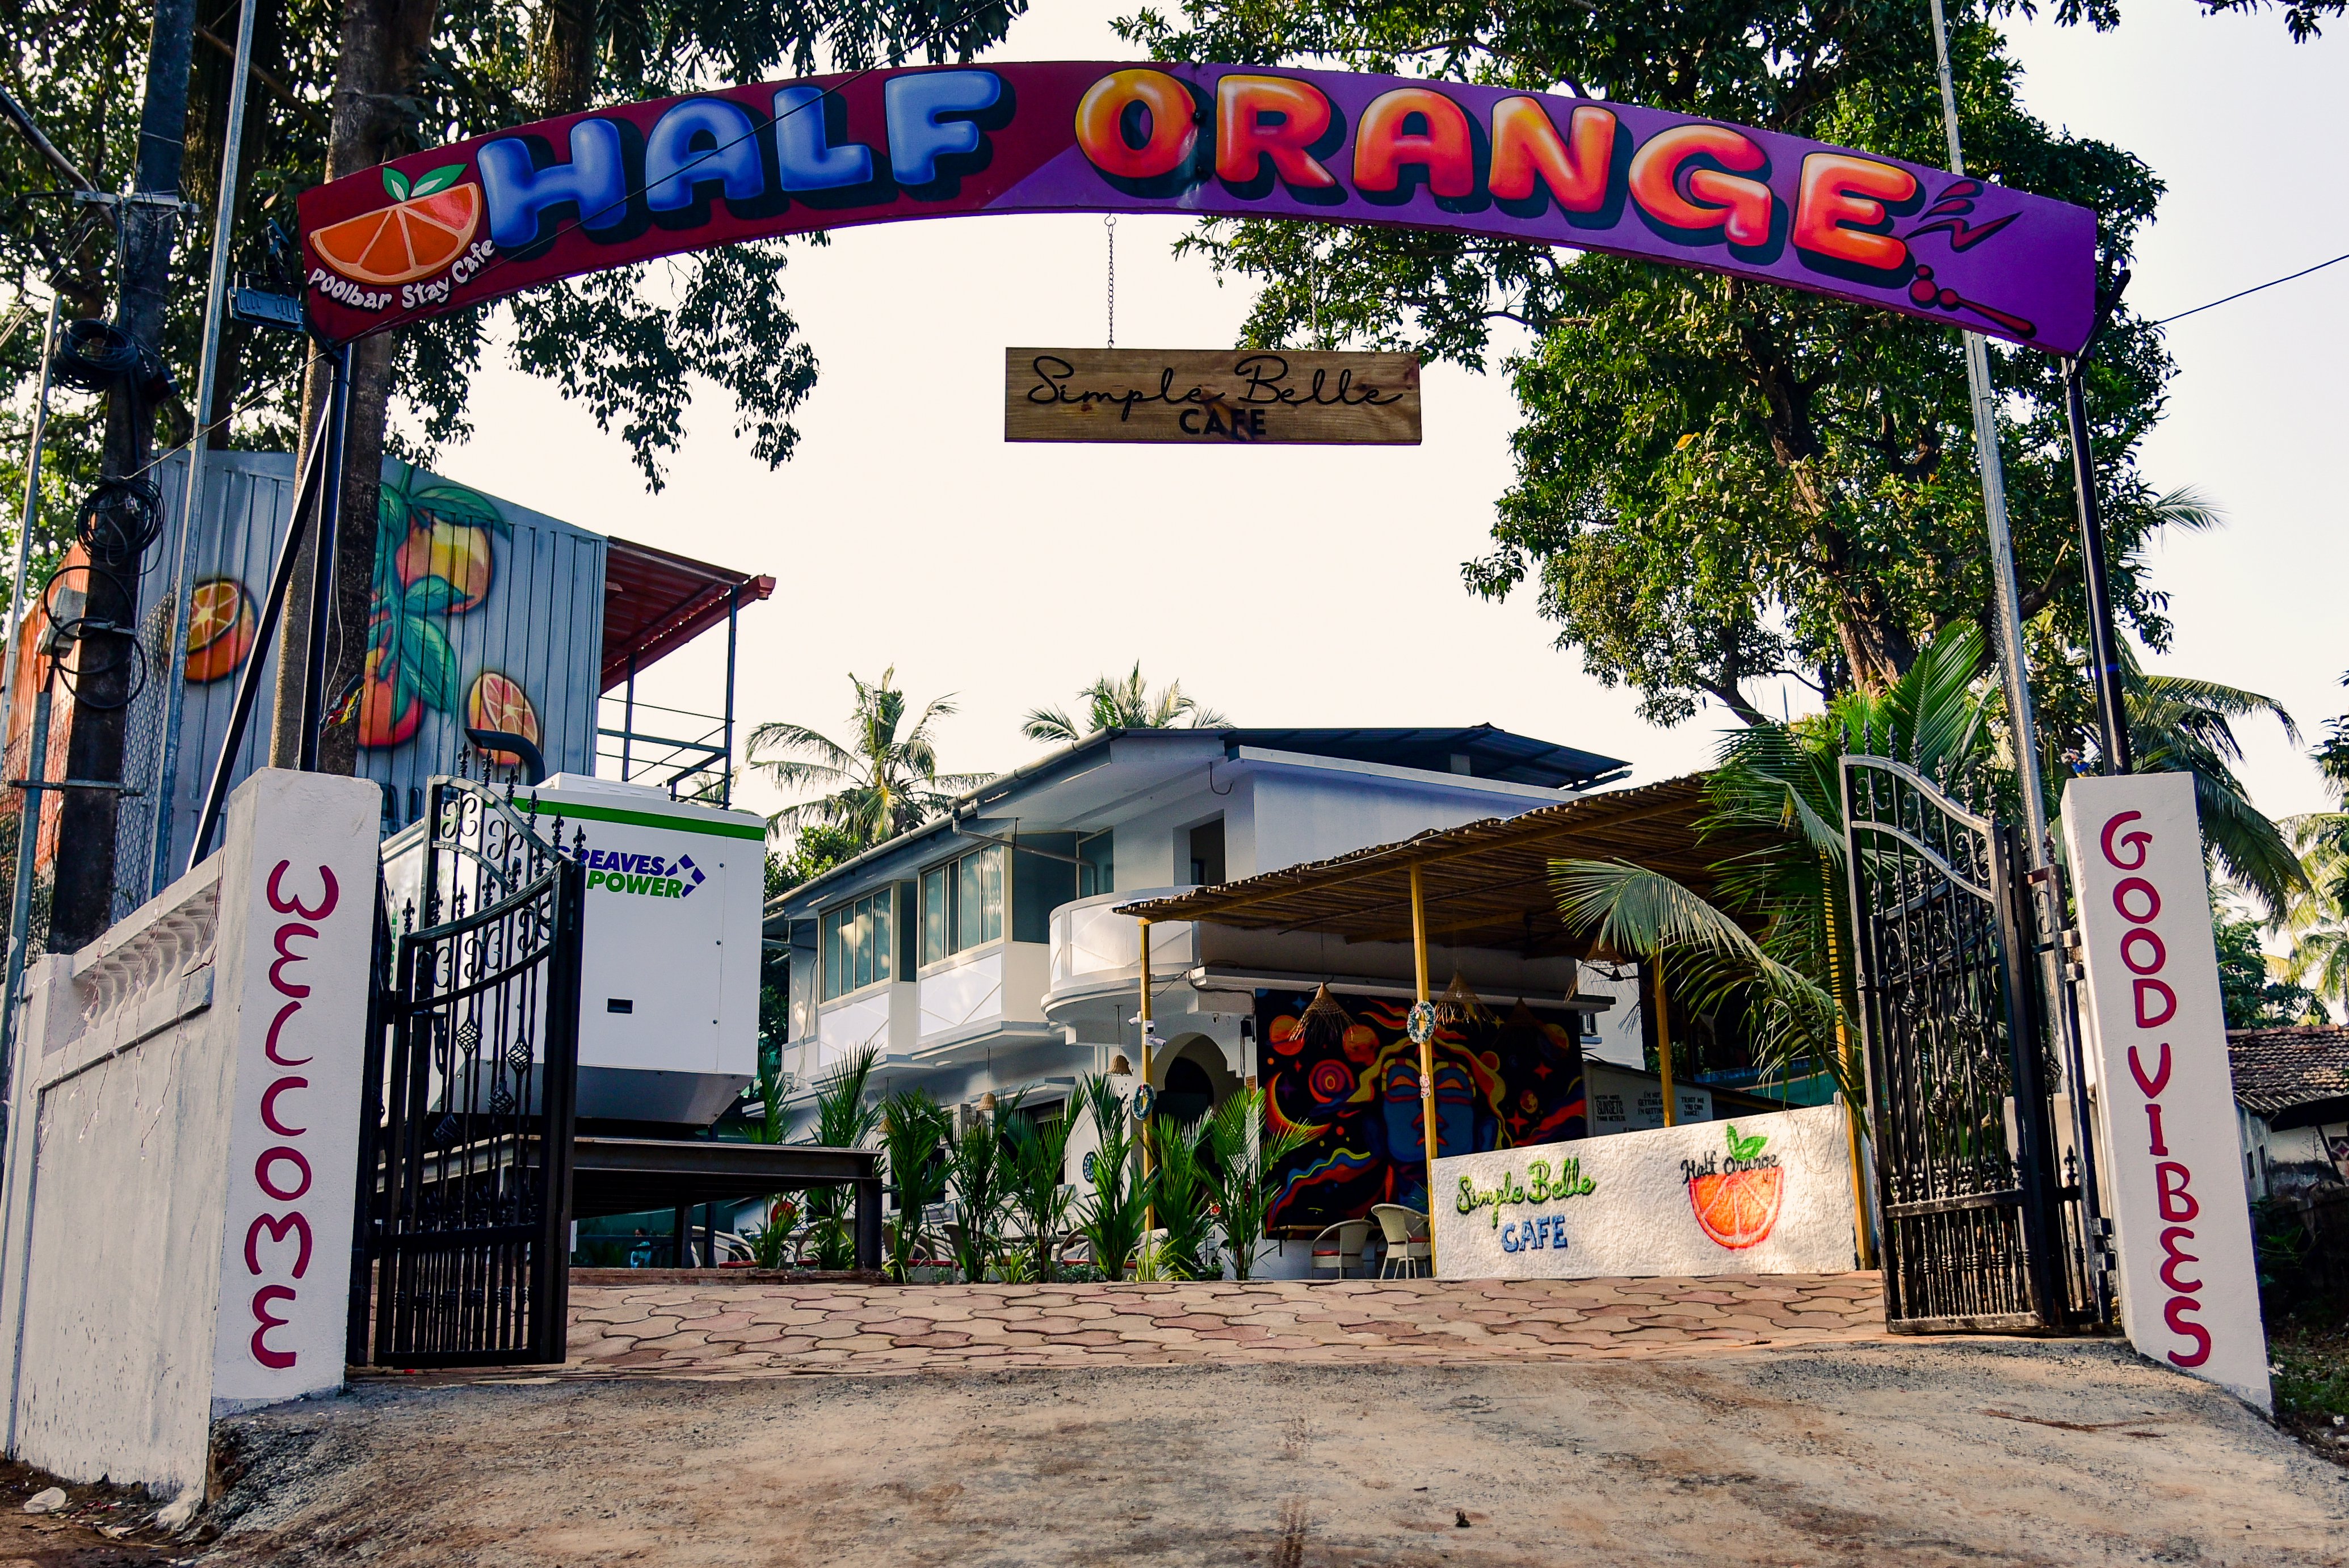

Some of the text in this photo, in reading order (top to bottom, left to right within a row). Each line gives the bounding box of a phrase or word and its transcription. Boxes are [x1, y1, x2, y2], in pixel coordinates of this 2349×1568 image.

[477, 68, 1918, 270] HALF ORANGE
[402, 277, 449, 308] Stay
[452, 239, 495, 283] Cafe
[1027, 354, 1404, 422] Simple Belle
[1179, 408, 1267, 436] CAFE
[586, 871, 683, 898] POWER
[2100, 810, 2178, 1028] GOOD
[244, 859, 339, 1369] WELCOME
[1596, 1100, 1624, 1115] SUNSETS
[1457, 1158, 1596, 1229] Simple Belle
[2127, 1042, 2212, 1368] VIBES
[1501, 1214, 1568, 1253] CAFE
